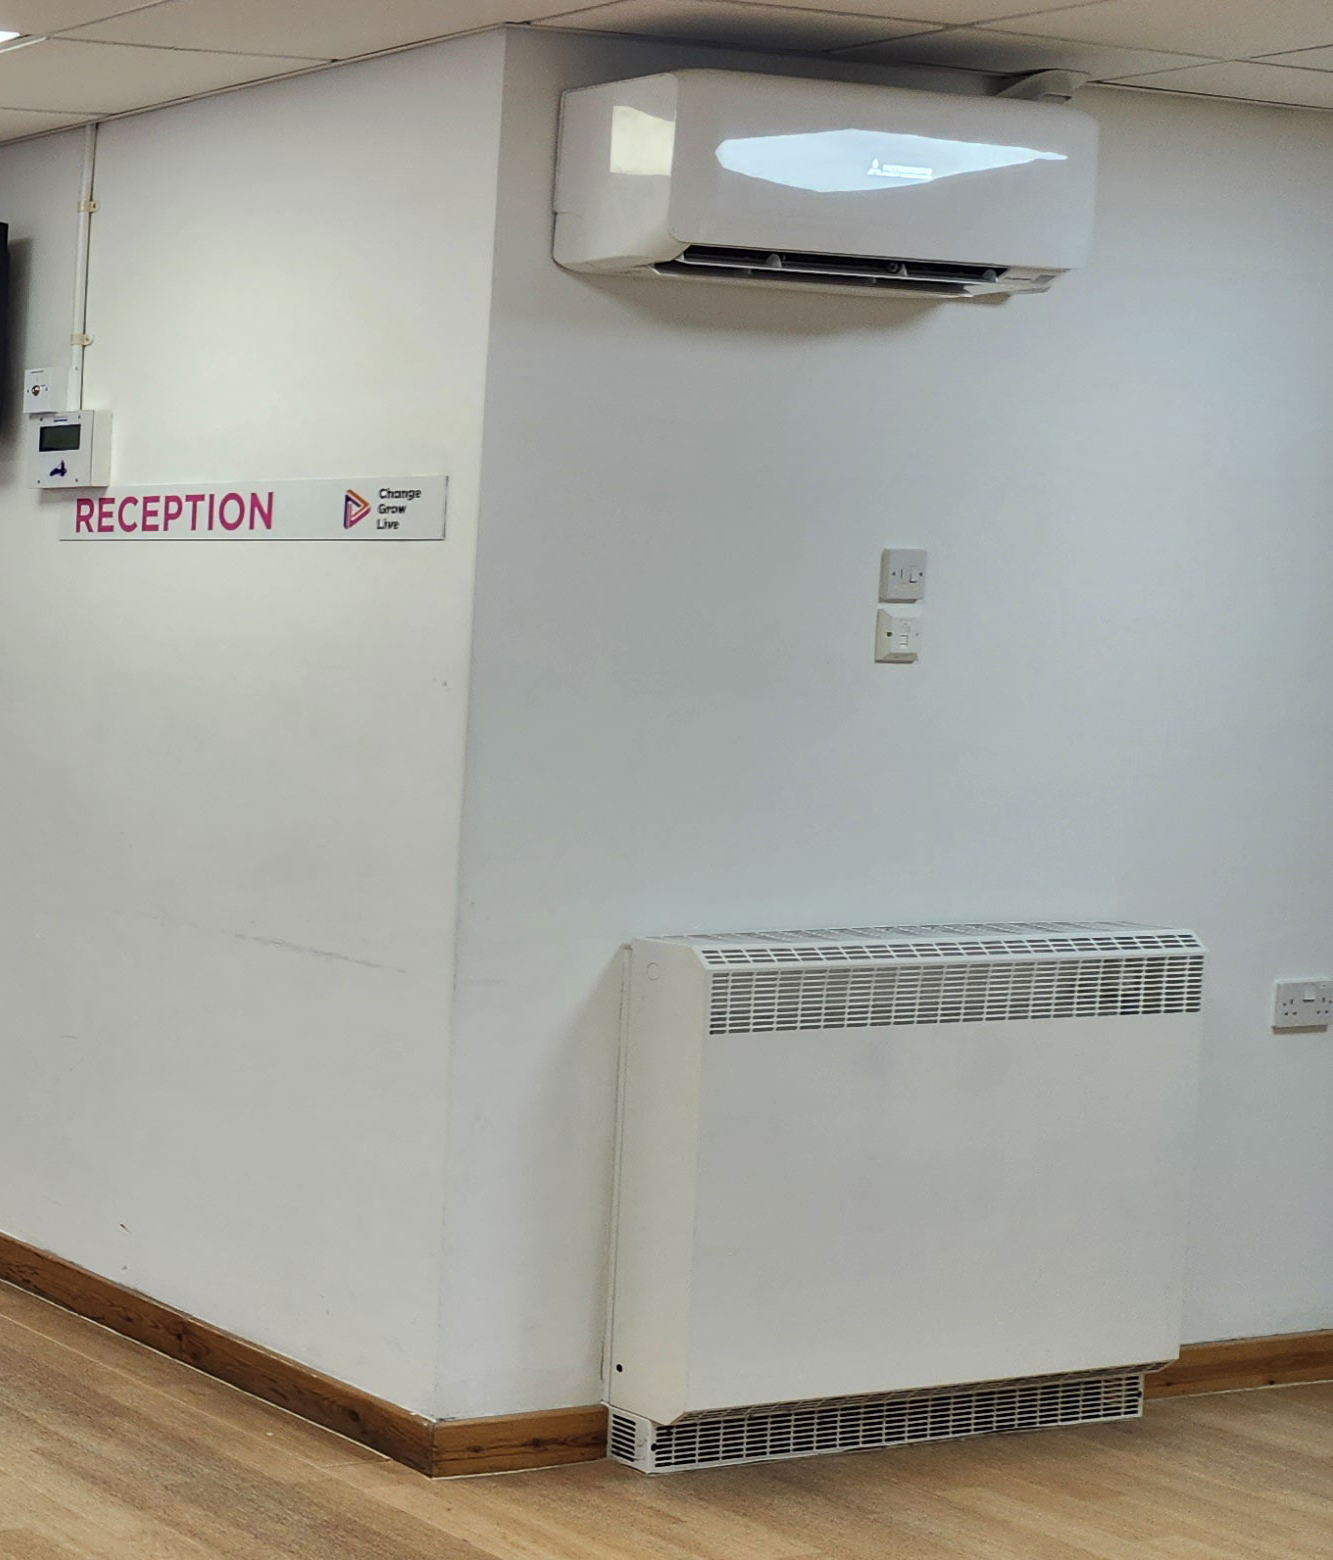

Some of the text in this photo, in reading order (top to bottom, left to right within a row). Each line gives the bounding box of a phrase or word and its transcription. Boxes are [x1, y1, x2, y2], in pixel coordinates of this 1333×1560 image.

[379, 488, 421, 500] Change
[75, 492, 273, 532] RECEPTION
[378, 504, 406, 513] Grow
[377, 519, 399, 529] Live
